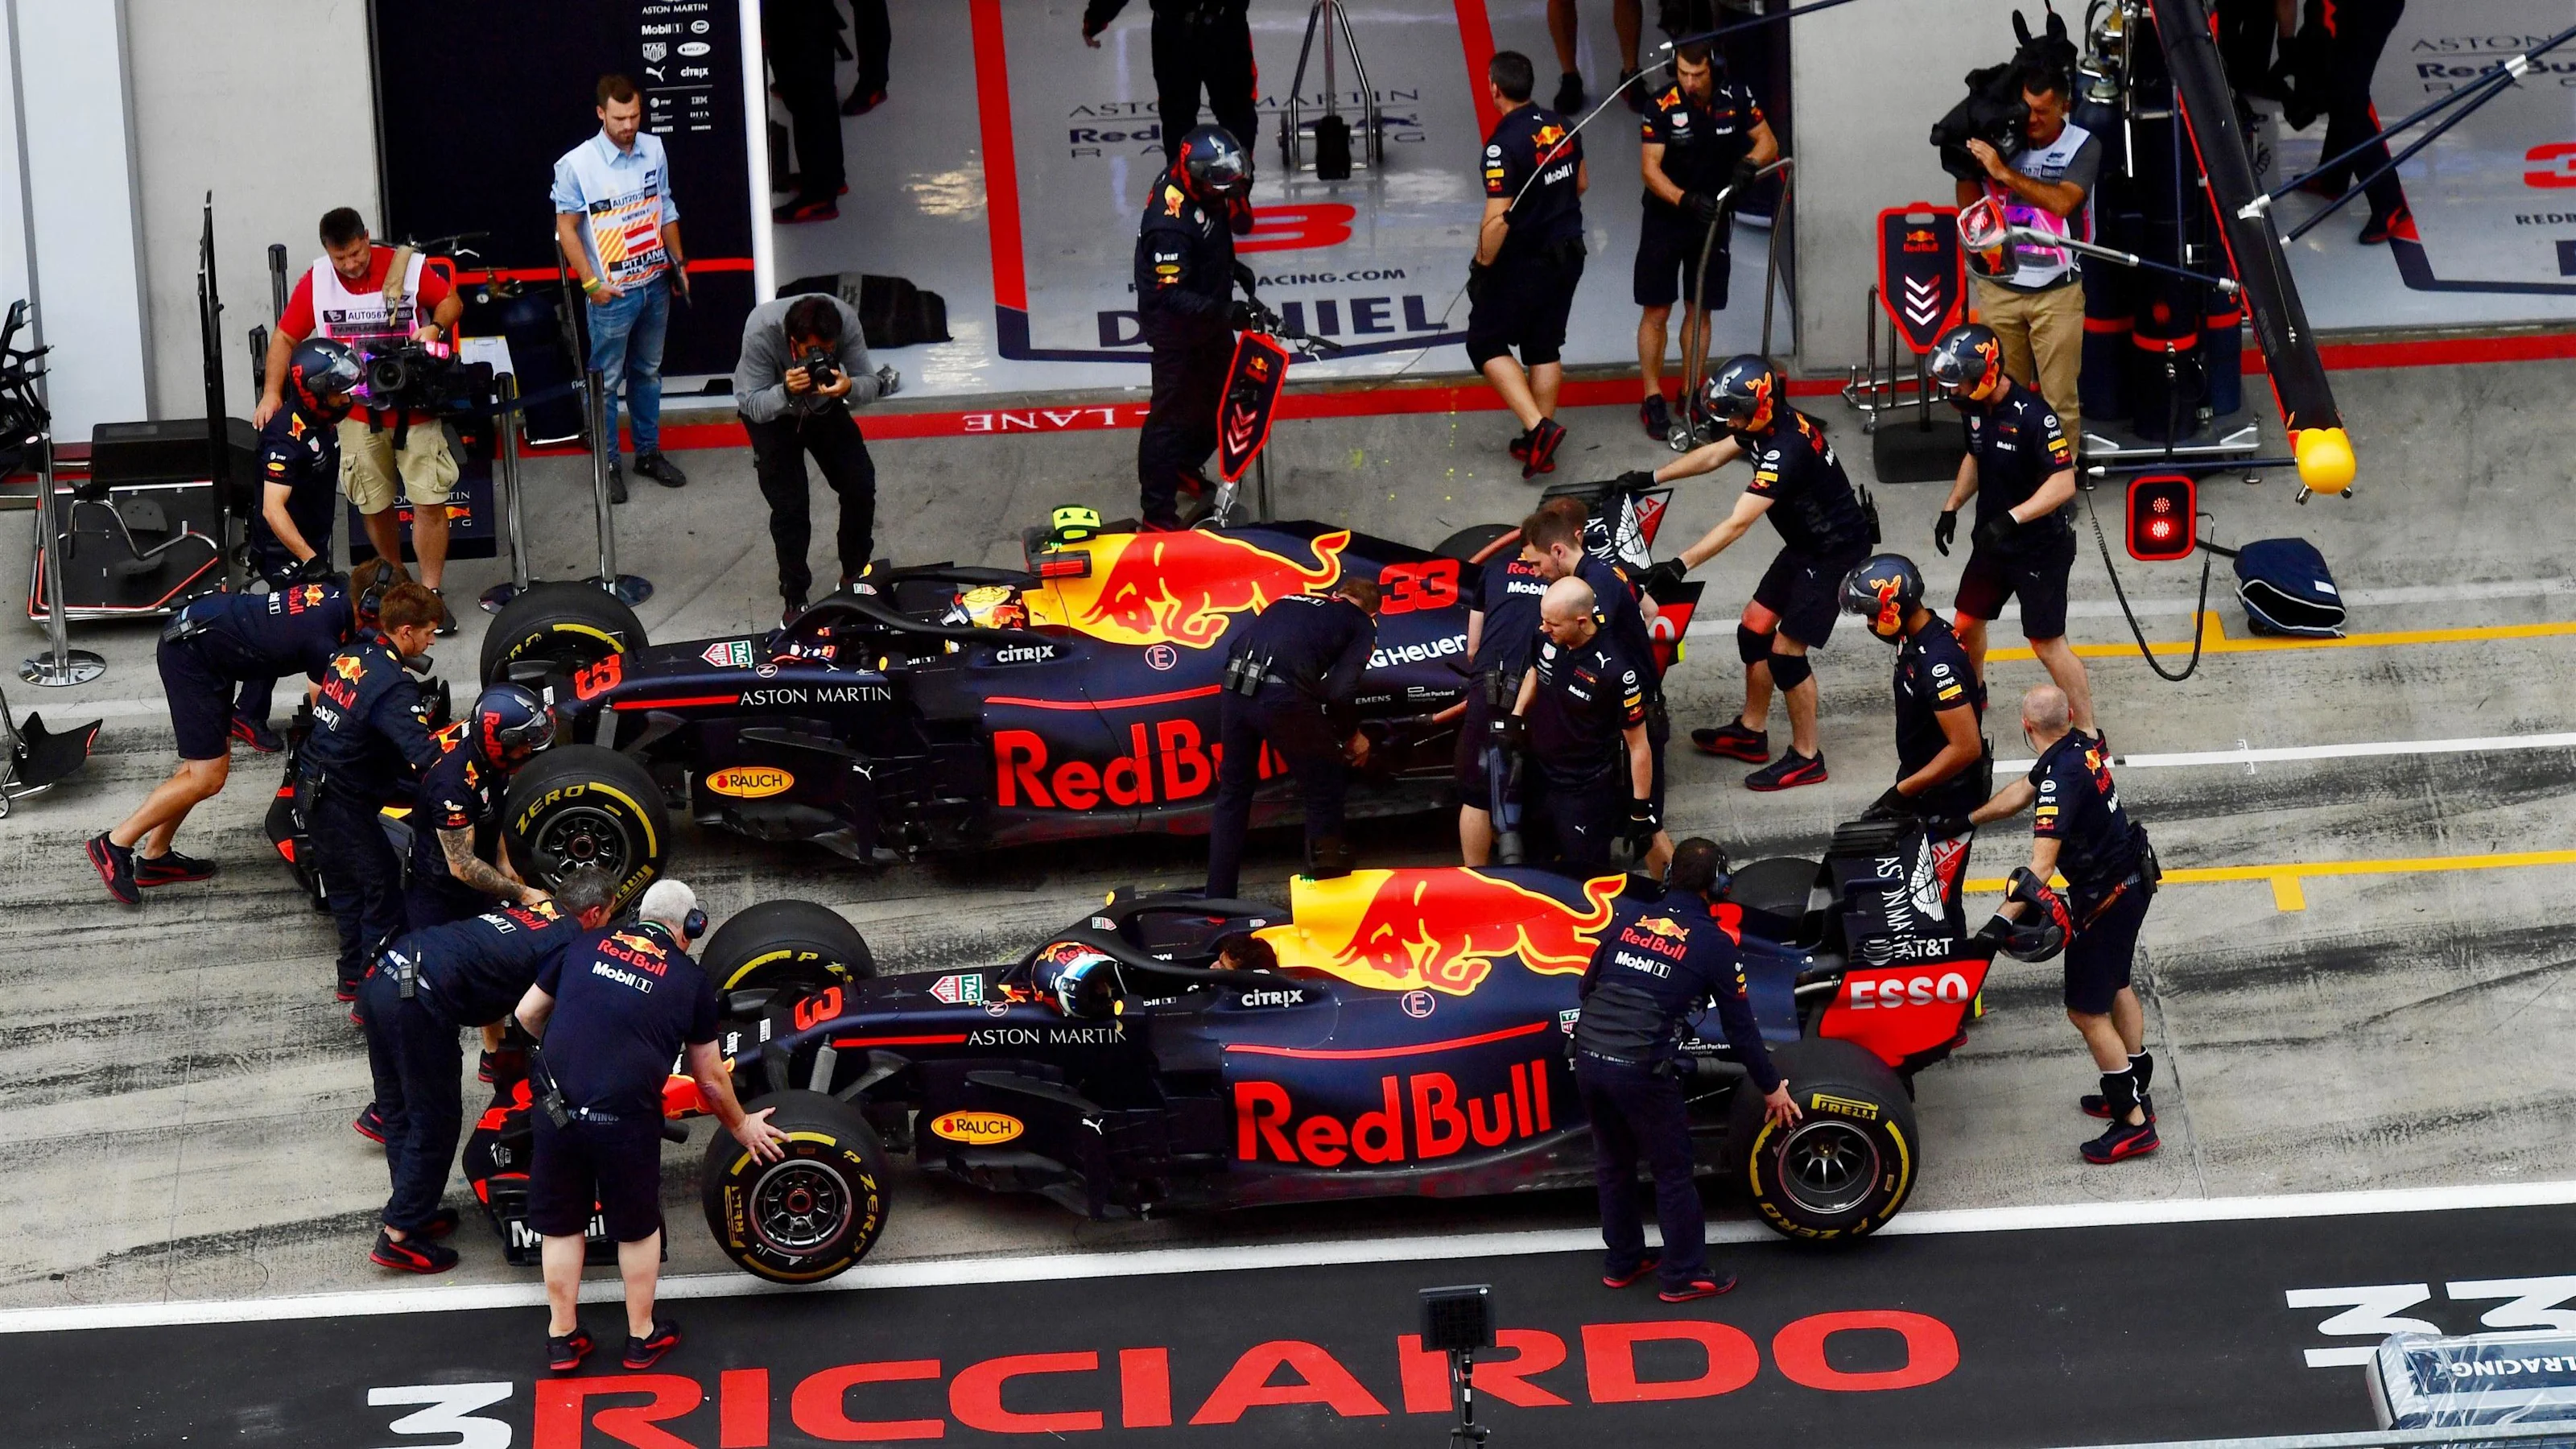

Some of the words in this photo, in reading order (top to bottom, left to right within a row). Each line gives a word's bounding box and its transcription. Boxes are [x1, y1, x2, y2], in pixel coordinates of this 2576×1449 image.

[642, 6, 671, 14] ASTON
[673, 3, 708, 13] MARTIN
[642, 23, 671, 35] Mobil
[691, 96, 708, 105] IBM
[1544, 164, 1570, 185] Mobil
[621, 257, 639, 270] PIT
[641, 248, 667, 266] LANE
[1163, 253, 1179, 261] AT&T
[963, 409, 1116, 432] LANE
[1380, 559, 1461, 616] 33
[1507, 581, 1547, 597] Mobil
[715, 644, 727, 666] HEUER
[734, 642, 746, 665] TAG
[575, 654, 622, 701] 33
[741, 690, 807, 706] ASTON
[816, 687, 891, 703] MARTIN
[1356, 695, 1392, 705] EMENS
[1568, 684, 1586, 699] Mobil
[729, 774, 783, 788] RAUCH
[515, 785, 586, 835] ZERO
[1902, 937, 1954, 959] AT&T
[592, 960, 636, 987] Mobil
[635, 977, 654, 994] 1
[1615, 952, 1653, 973] Mobil
[1653, 961, 1671, 980] 1
[942, 976, 958, 1001] HEUER
[964, 975, 976, 1001] TAG
[1851, 972, 1969, 1009] ESSO
[795, 987, 843, 1031] 3
[968, 1030, 1040, 1046] ASTON
[1050, 1028, 1127, 1045] MARTIN
[1811, 1092, 1880, 1121] PIRELLI
[956, 1117, 1011, 1135] RAUCH
[534, 1310, 1960, 1449] RICCIARDO
